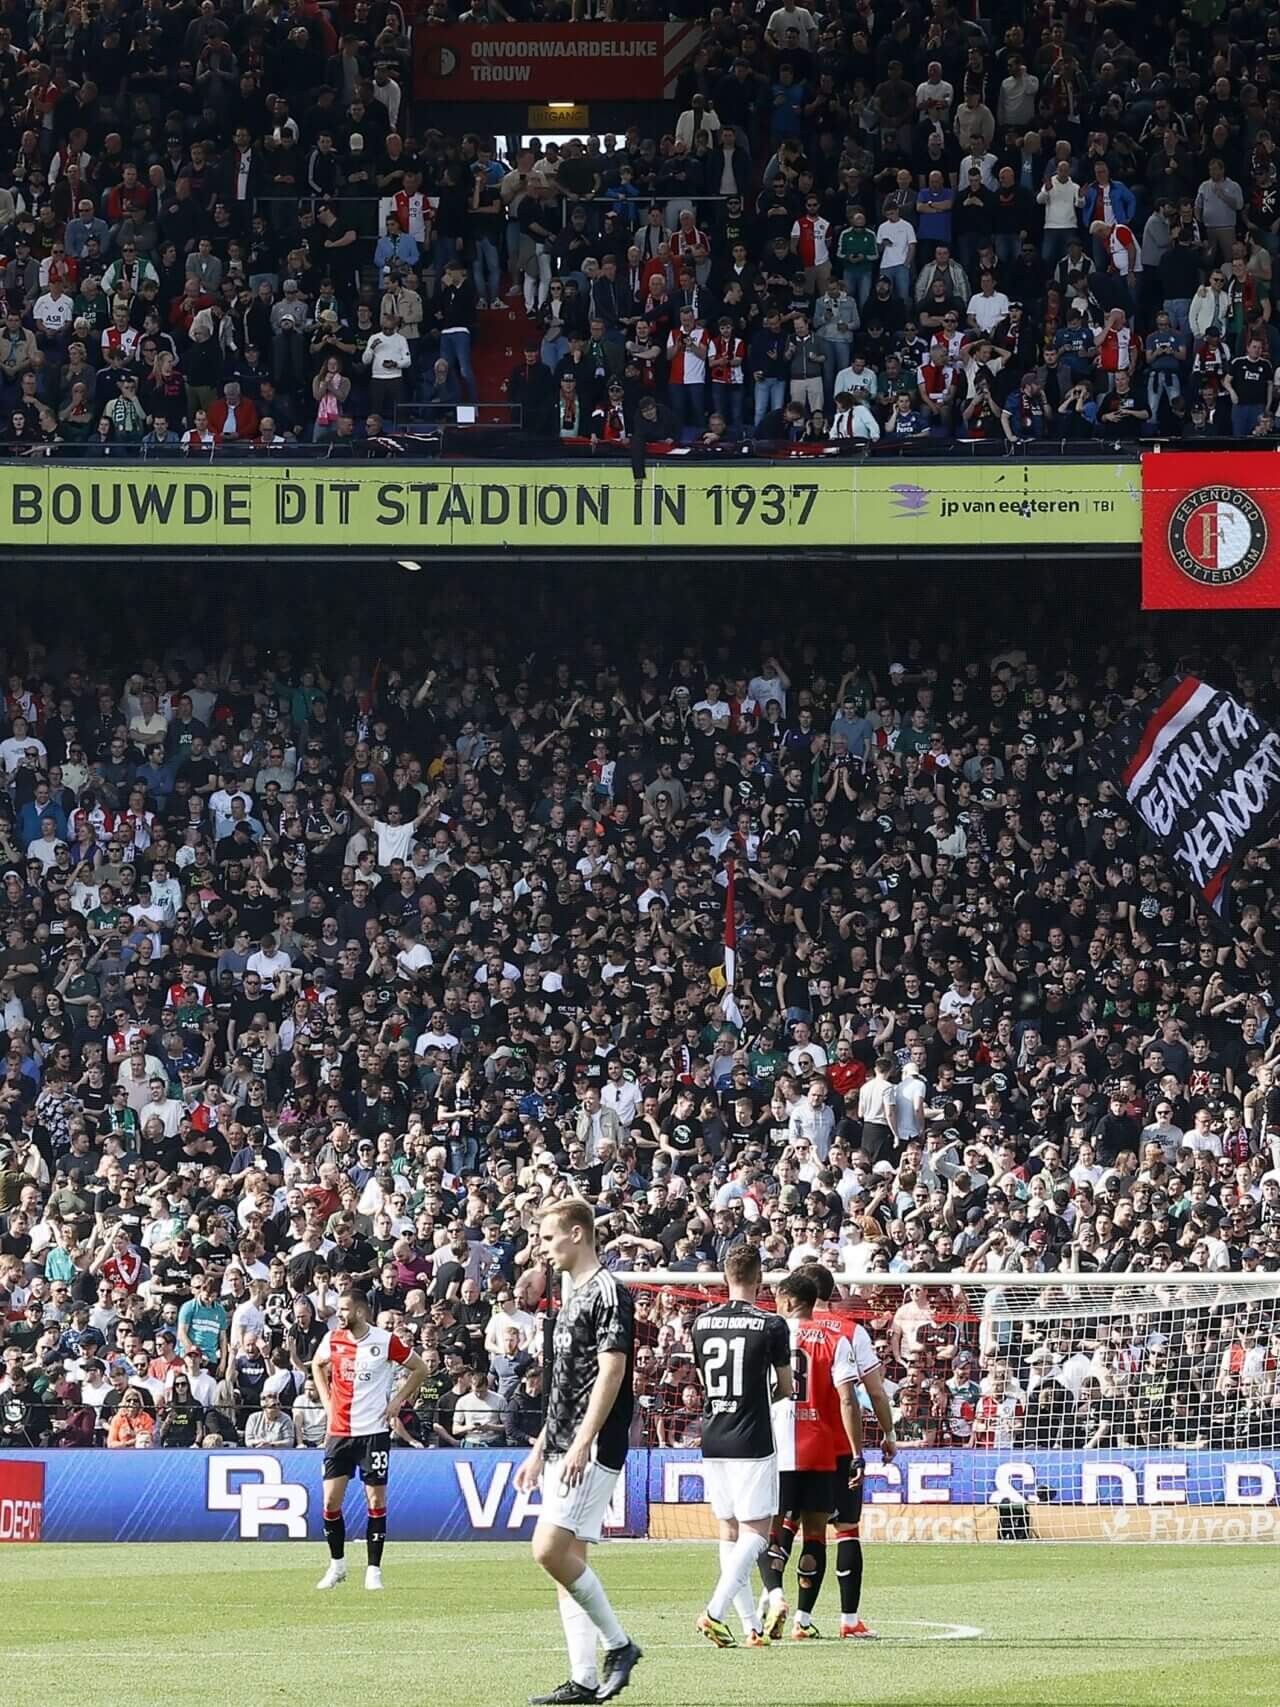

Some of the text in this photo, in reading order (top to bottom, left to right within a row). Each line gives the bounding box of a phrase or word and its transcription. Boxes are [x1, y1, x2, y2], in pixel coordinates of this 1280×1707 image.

[471, 41, 657, 57] ONVOORWAARDELIJKE
[471, 65, 532, 81] TROUW
[12, 483, 819, 526] BOUWDE DIT STADION IN 1937
[940, 498, 959, 517] jp
[962, 501, 996, 513] van
[1093, 500, 1115, 513] TBI
[1176, 489, 1260, 525] FEYENOORD
[1175, 548, 1260, 583] ROTTERDAM
[711, 1317, 728, 1330] DEN
[728, 1317, 766, 1331] BOOMEN
[702, 1336, 746, 1398] 21
[371, 1452, 389, 1469] 33
